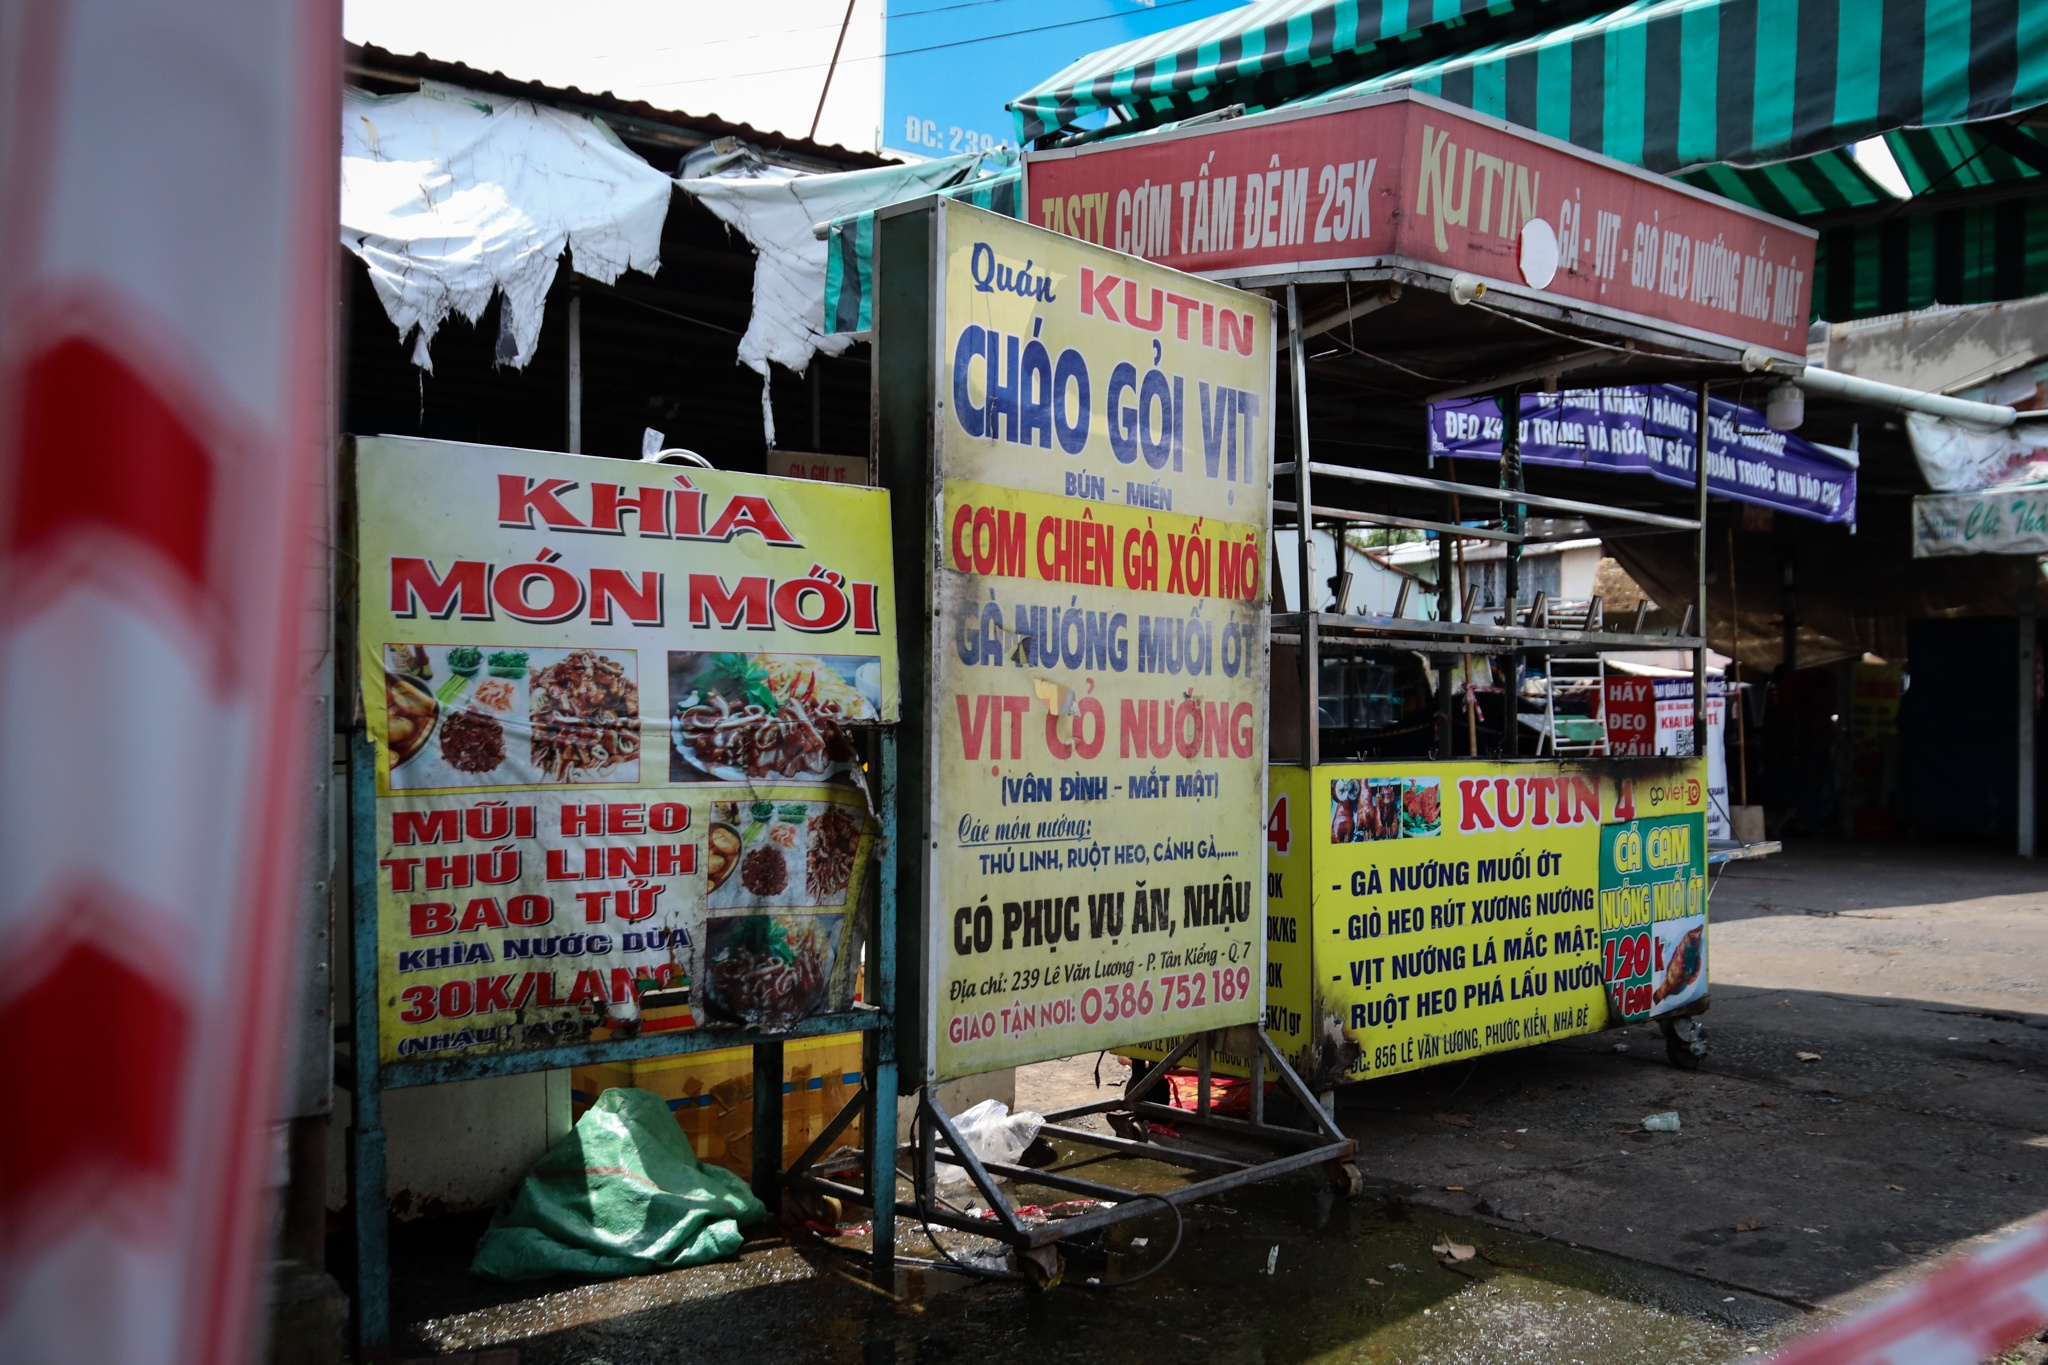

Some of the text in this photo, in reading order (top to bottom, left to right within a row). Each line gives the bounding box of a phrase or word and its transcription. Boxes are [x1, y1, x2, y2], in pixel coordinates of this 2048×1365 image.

[905, 115, 944, 149] ĐC:
[950, 126, 993, 154] 239
[1042, 150, 1377, 257] TASTY CƠM TẤM ĐÊM 25K
[1416, 124, 1541, 253] KUTIN
[1557, 187, 1581, 272] GÀ
[1595, 209, 1621, 294] VỊT
[1631, 210, 1659, 291] GIÒ
[1659, 229, 1691, 300] HEO
[1691, 233, 1741, 313] NƯỚNG
[1773, 254, 1803, 340] MẬT
[971, 242, 1255, 357] Quán KUTIN
[953, 317, 1260, 507] CHÁO GỎI VỊT
[1445, 411, 1480, 440] ĐEO
[1587, 421, 1609, 452] VÀ
[1666, 438, 1692, 470] SÁT
[1776, 469, 1797, 497] KHI
[1799, 473, 1821, 502] VÀO
[497, 474, 803, 548] KHÌA
[1064, 469, 1173, 511] BÚN MIẾN
[952, 504, 1259, 602] CƠM CHIÊN GÀ XỐI MỠ
[390, 547, 880, 635] MÓN MỚI
[955, 588, 1253, 678] GÀ NƯỚNG MUỐI ỚT
[1609, 681, 1647, 701] HÃY
[1609, 713, 1647, 730] ĐEO
[955, 678, 1254, 777] VỊT CỎ NƯỚNG
[1001, 766, 1219, 806] (VÂN ĐÌNH MẮT MẬT)
[1457, 775, 1635, 834] KUTIN 4
[391, 800, 693, 845] MŨI HEO
[958, 813, 1092, 845] Các món nướng:
[1268, 796, 1290, 852] 4
[1614, 821, 1690, 875] CÁ CAM
[381, 842, 698, 894] THÚ LINH
[979, 847, 1015, 875] THÚ
[1020, 849, 1064, 872] LINH,
[1067, 841, 1111, 872] RUỘT
[1114, 844, 1150, 866] HEO,
[1153, 836, 1194, 862] CÁNH
[1351, 848, 1563, 896] GÀ NƯỚNG MUỐI ỚT
[409, 878, 666, 939] BAO TỬ
[954, 873, 1251, 955] CÓ PHỤC VỤ ĂN, NHẬU
[1348, 887, 1594, 940] GIÒ HEO RÚT XƯƠNG NƯỚNG
[1601, 866, 1704, 931] NƯỚNG MUỐI ỚT
[400, 925, 692, 973] KHÌA NƯỚC DỪA
[950, 979, 976, 1004] Địa
[980, 972, 1007, 996] chỉ:
[1012, 969, 1040, 993] 239
[1043, 965, 1062, 987] Lê
[1064, 962, 1091, 983] Văn
[1094, 956, 1134, 982] Lương
[1146, 953, 1157, 972] P.
[1160, 951, 1182, 969] Tân
[1184, 943, 1218, 968] Kiểng
[1350, 924, 1600, 990] VỊT NƯỚNG LÁ MẮC MẬT:
[950, 966, 1251, 1044] GIAO TẬN NƠI: 0386 752 189
[1351, 961, 1605, 1029] RUỘT HEO PHÁ LẤU NƯỚN
[1375, 1044, 1397, 1069] 856
[1401, 1036, 1414, 1063] LÊ
[1417, 1033, 1440, 1060] VĂN
[1444, 1026, 1482, 1055] LƯƠNG,
[1485, 1019, 1521, 1046] PHƯỚC
[1523, 1007, 1550, 1041] KIỂN,
[1553, 1005, 1574, 1032] NHÀ
[1577, 1003, 1590, 1028] BÈ
